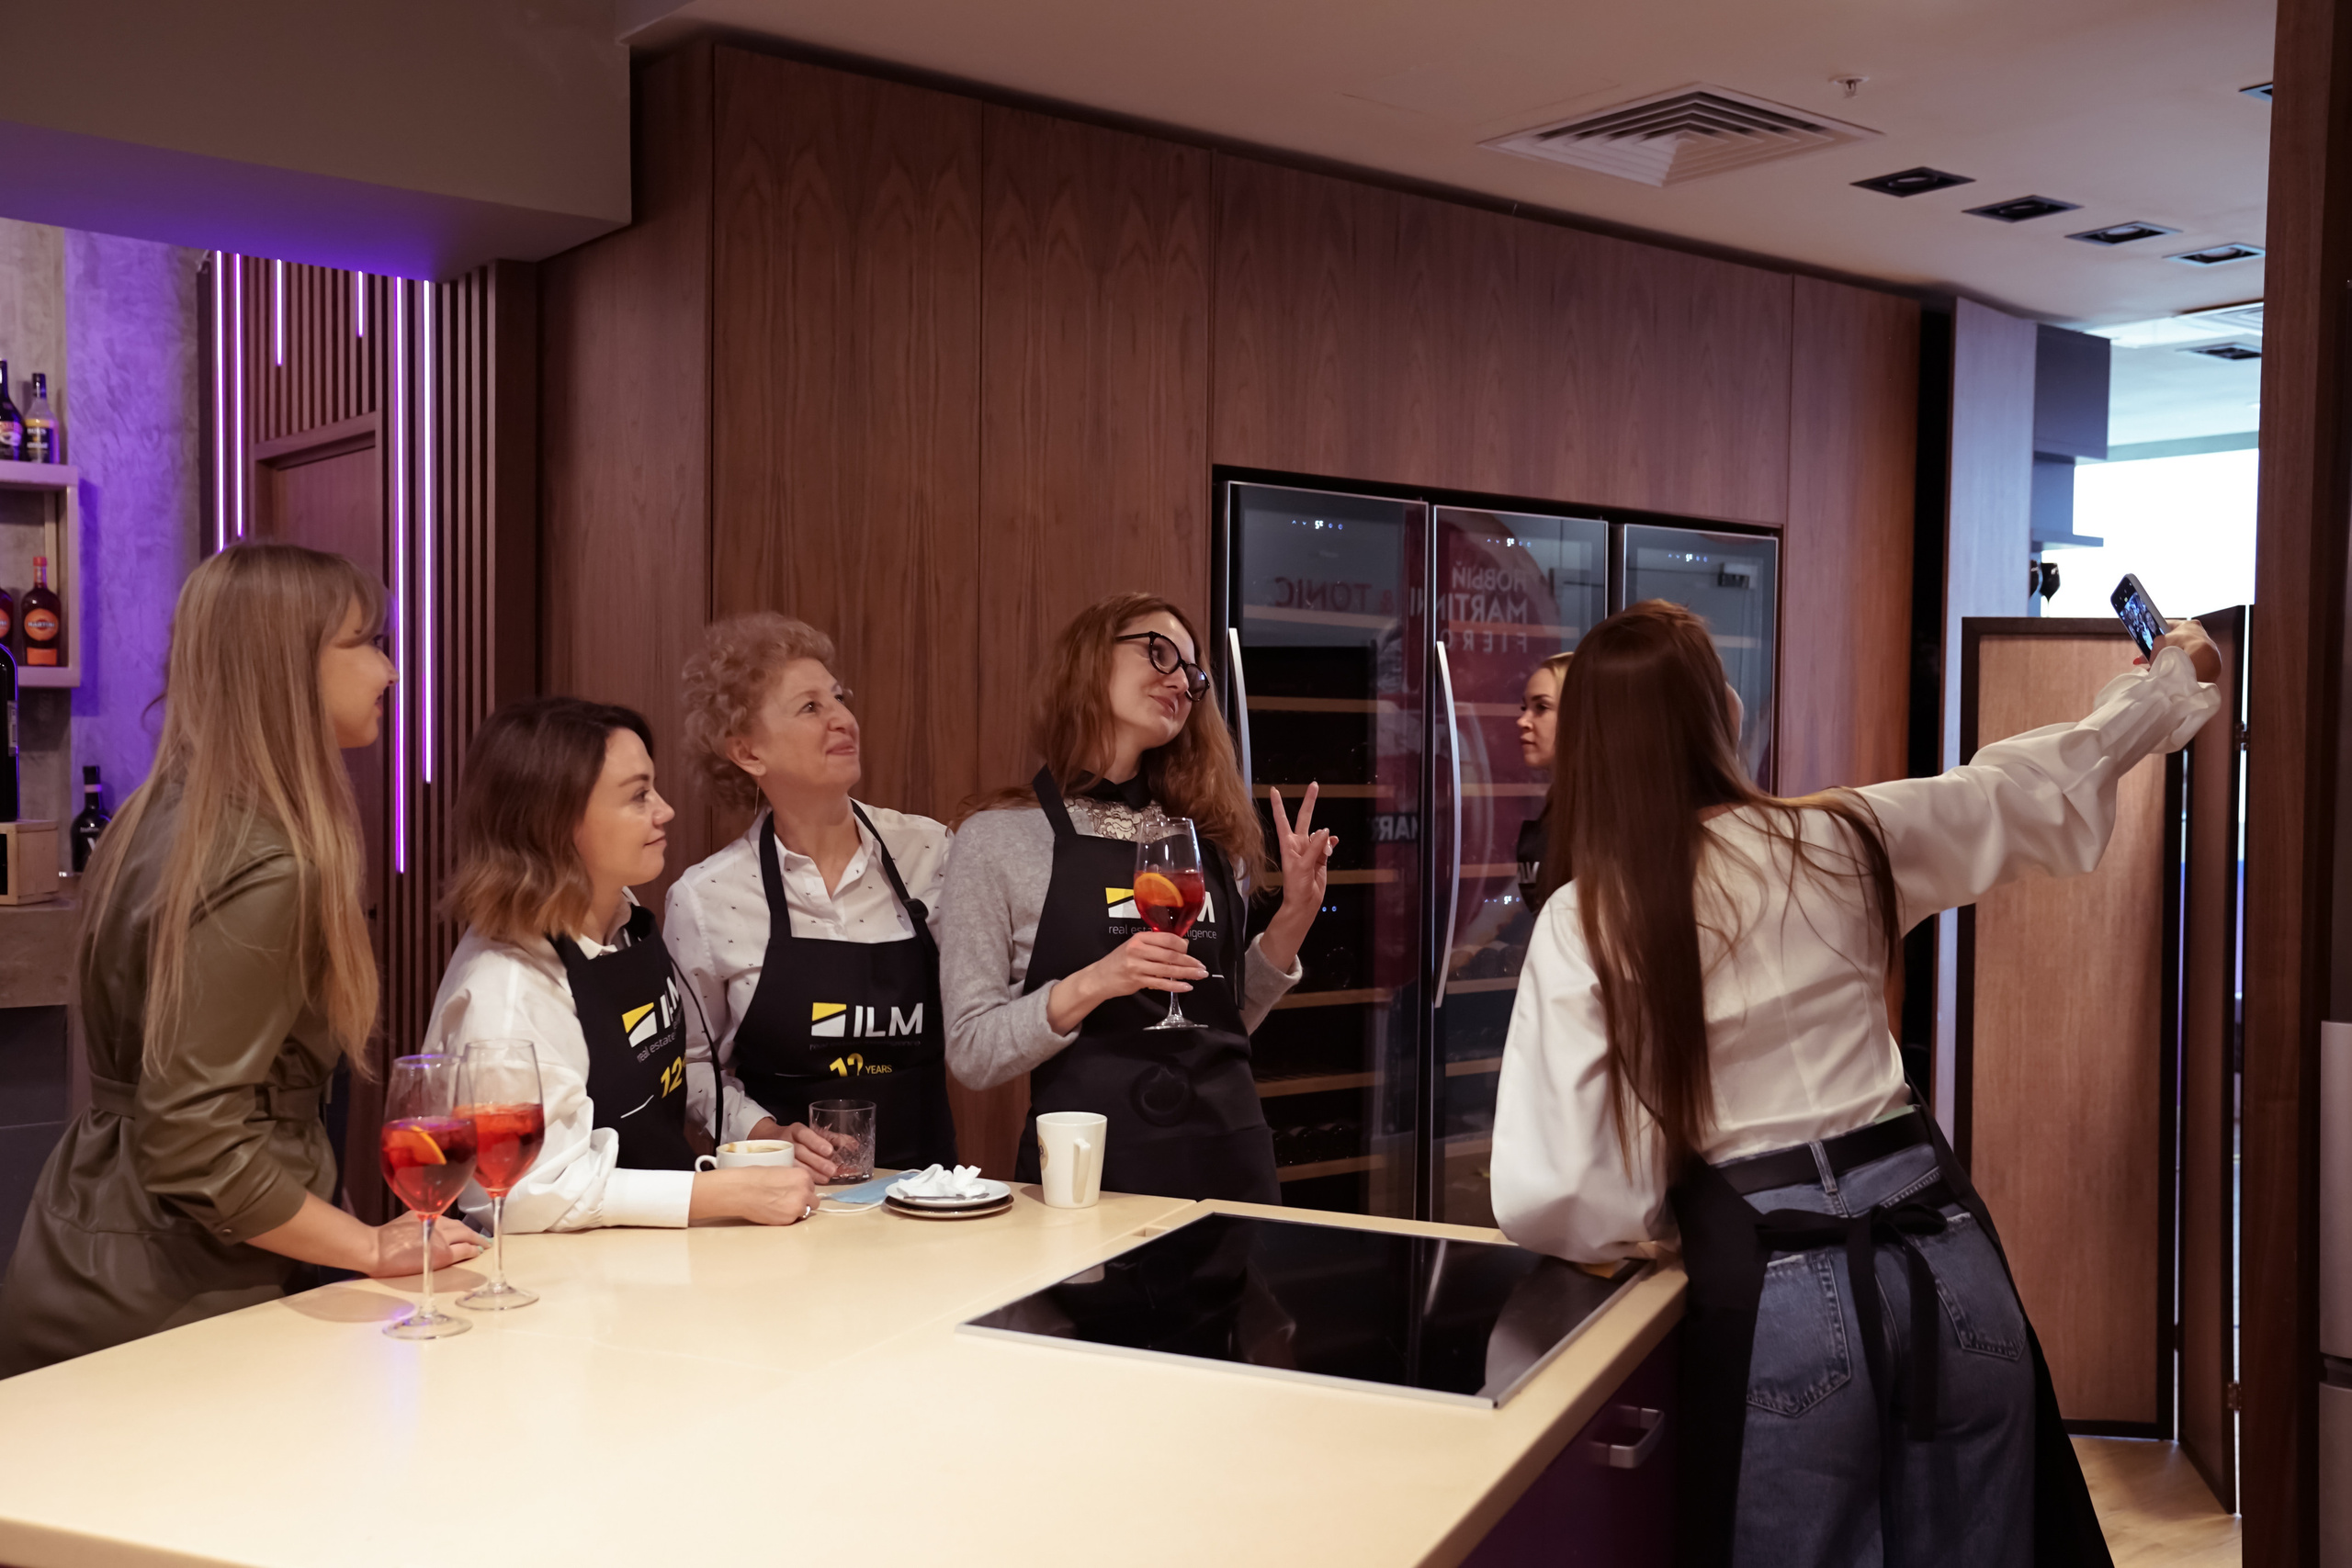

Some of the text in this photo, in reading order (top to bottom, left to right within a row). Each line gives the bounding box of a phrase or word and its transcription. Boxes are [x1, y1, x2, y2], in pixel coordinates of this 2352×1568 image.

[1108, 924, 1128, 935] real
[853, 1001, 924, 1038] ILM
[636, 1031, 676, 1064] real estate
[661, 1055, 683, 1099] 12
[865, 1064, 894, 1076] YEARS
